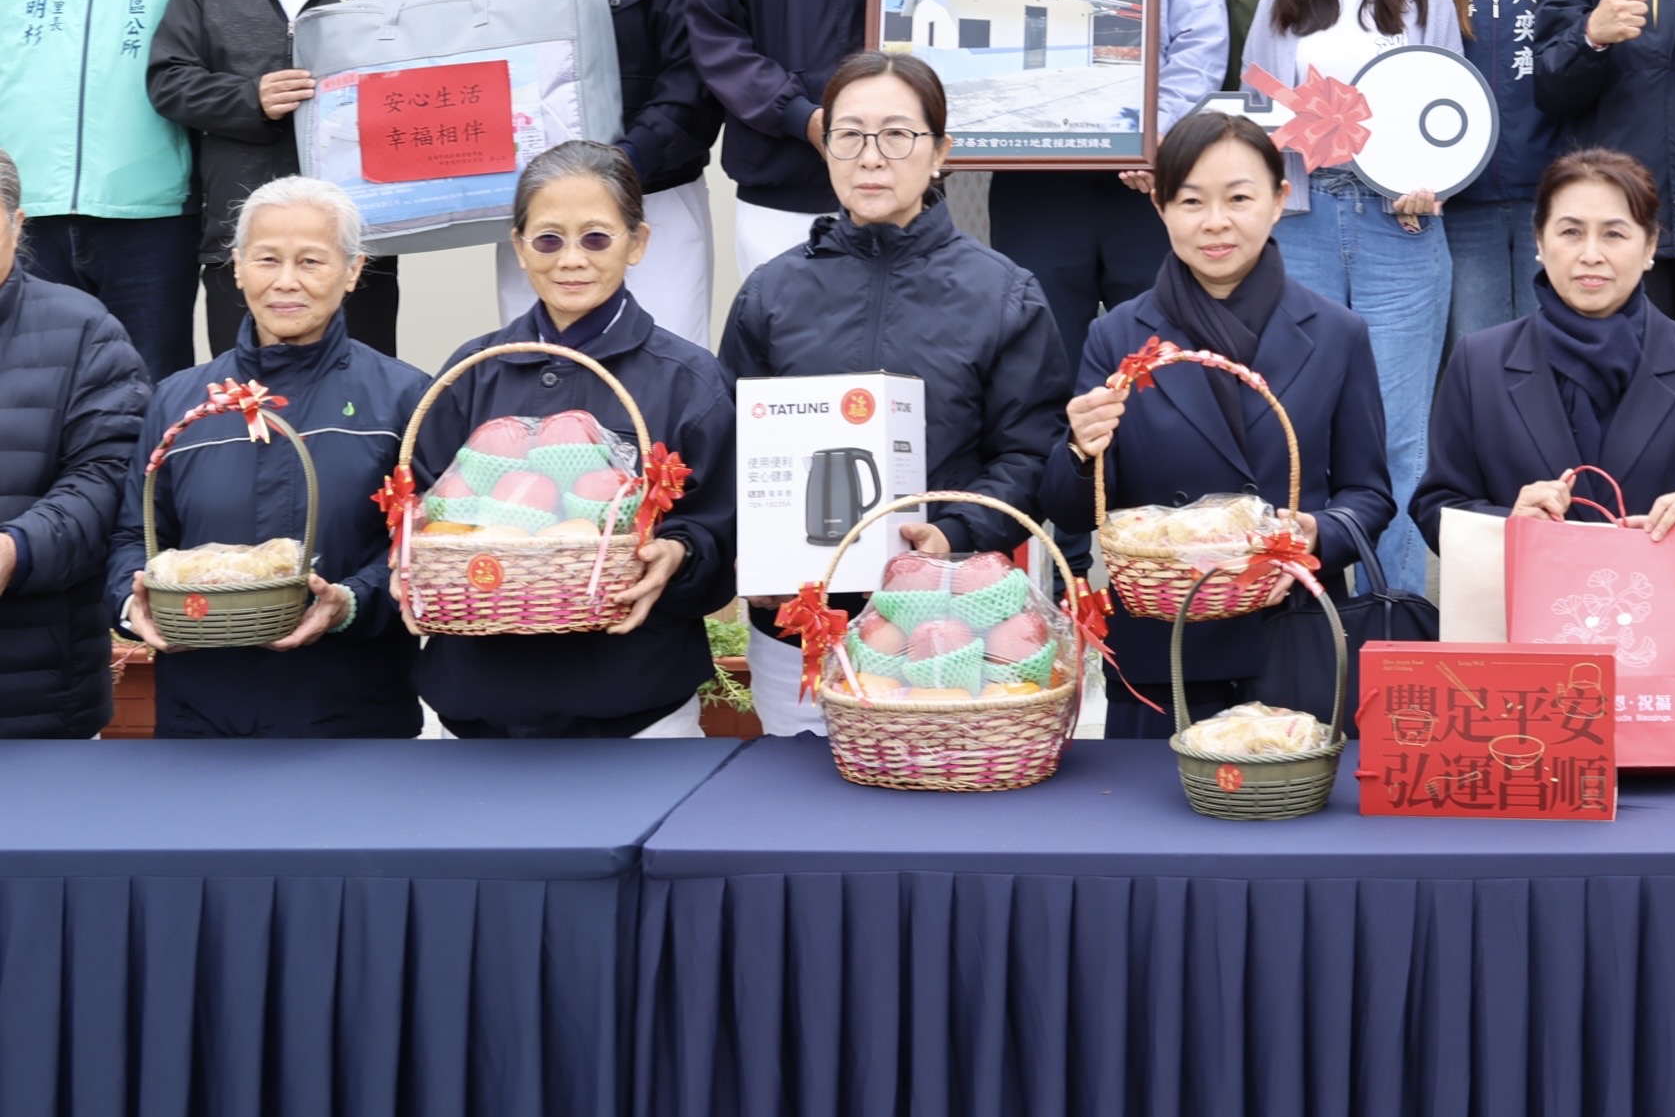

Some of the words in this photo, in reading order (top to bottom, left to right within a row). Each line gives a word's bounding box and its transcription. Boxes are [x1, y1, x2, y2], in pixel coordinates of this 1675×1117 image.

[383, 83, 483, 113] 安心生活
[385, 120, 486, 151] 幸福相伴
[768, 402, 830, 415] TATUNG
[1382, 684, 1607, 747] 豐足平安
[1382, 751, 1607, 815] 弘運昌順
